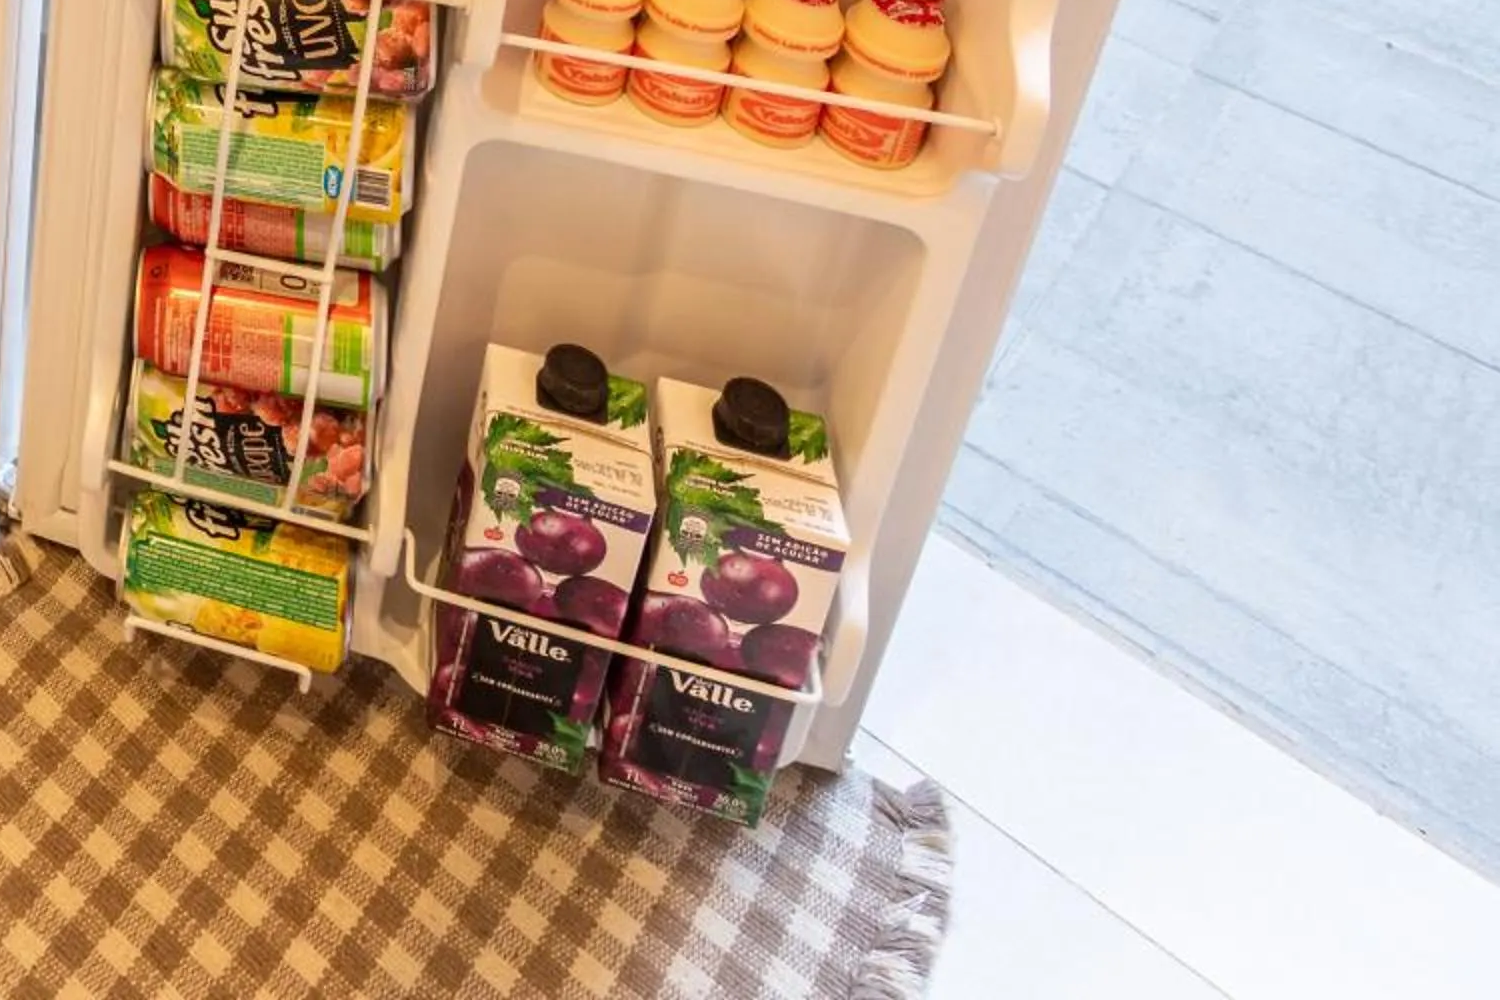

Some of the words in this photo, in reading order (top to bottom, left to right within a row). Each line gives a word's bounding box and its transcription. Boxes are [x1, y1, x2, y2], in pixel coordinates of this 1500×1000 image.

[566, 494, 590, 508] SEM
[755, 540, 771, 552] DE
[757, 532, 782, 547] SEM
[487, 620, 569, 662] Valle
[669, 669, 754, 714] Valle
